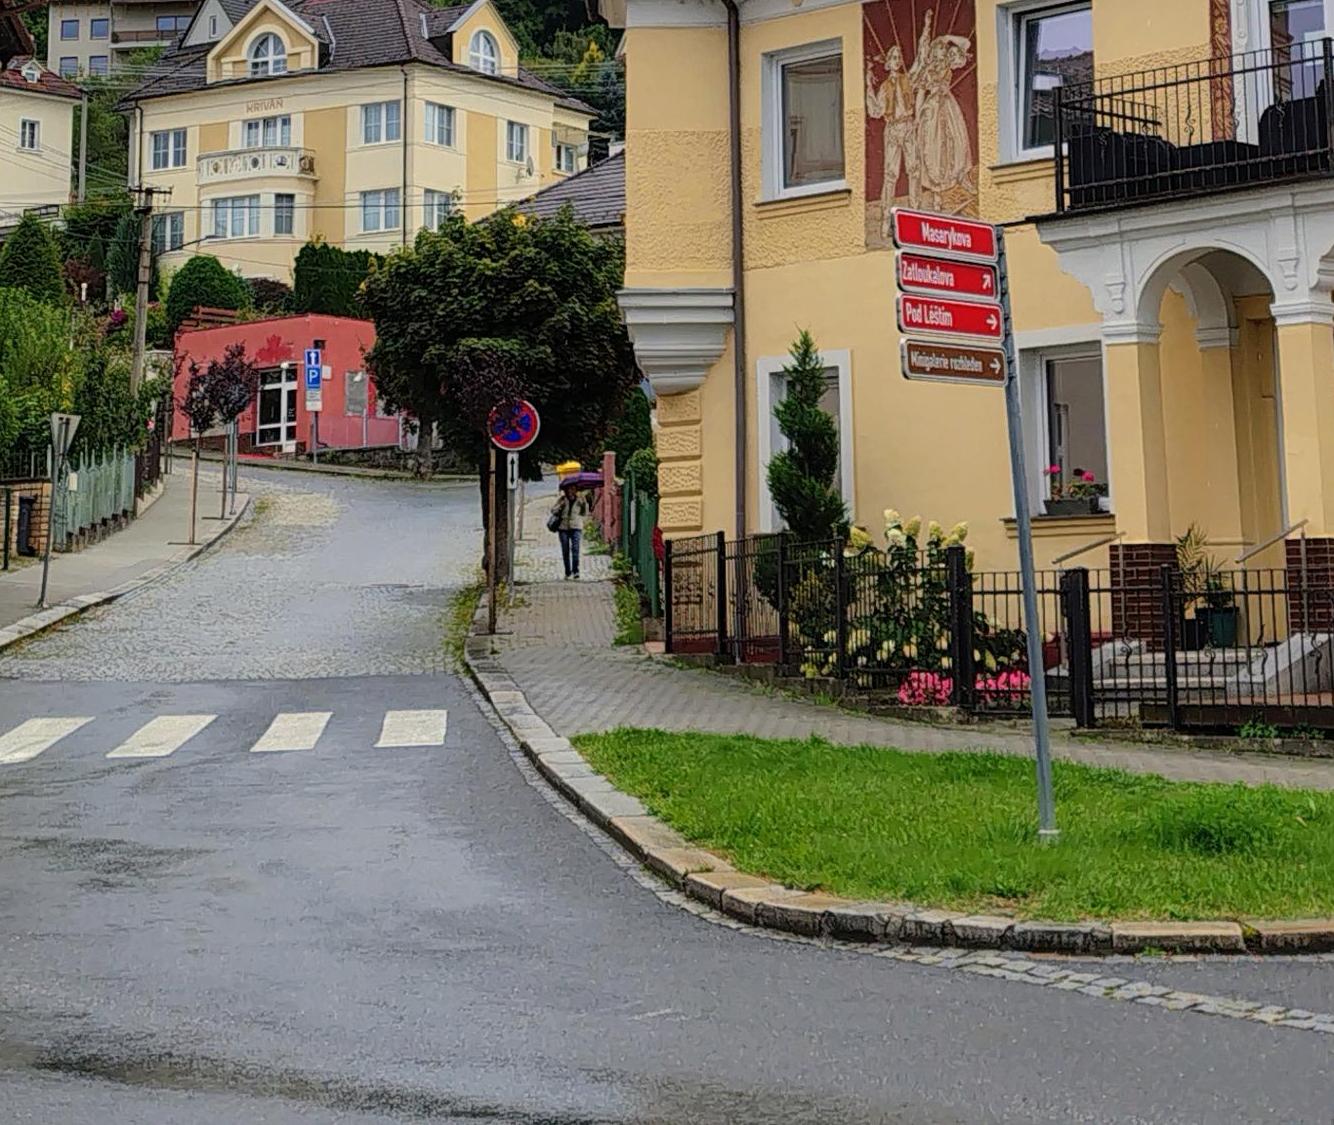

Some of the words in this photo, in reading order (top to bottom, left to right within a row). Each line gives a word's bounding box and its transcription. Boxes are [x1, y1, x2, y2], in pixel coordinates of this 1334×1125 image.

[921, 221, 972, 250] Masarykova
[901, 260, 955, 287] Zatloukalova
[905, 302, 923, 323] Pod
[309, 369, 318, 383] P
